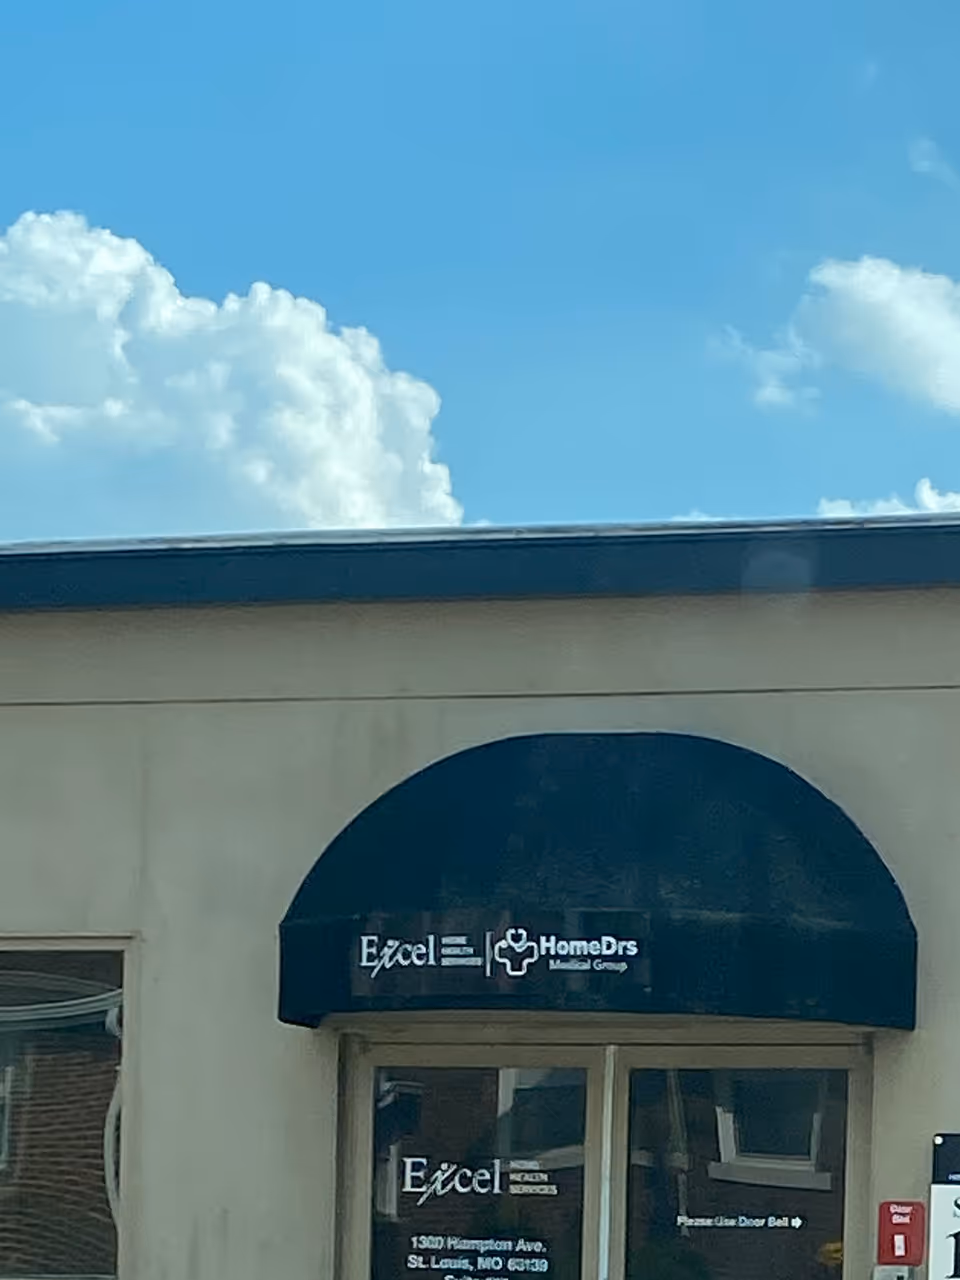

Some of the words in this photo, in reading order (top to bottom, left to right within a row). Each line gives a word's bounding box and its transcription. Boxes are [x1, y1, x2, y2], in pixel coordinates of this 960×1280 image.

[540, 935, 639, 956] HomeDrs
[360, 934, 437, 978] Excel
[549, 959, 591, 970] Medical
[592, 959, 628, 974] Group
[401, 1157, 503, 1206] Excel
[738, 1215, 766, 1228] Door
[767, 1216, 789, 1228] Bell
[446, 1236, 513, 1253] Hampton
[515, 1238, 547, 1253] Ave.
[407, 1254, 429, 1269] St.
[430, 1255, 474, 1272] Louis,
[477, 1256, 503, 1270] MO
